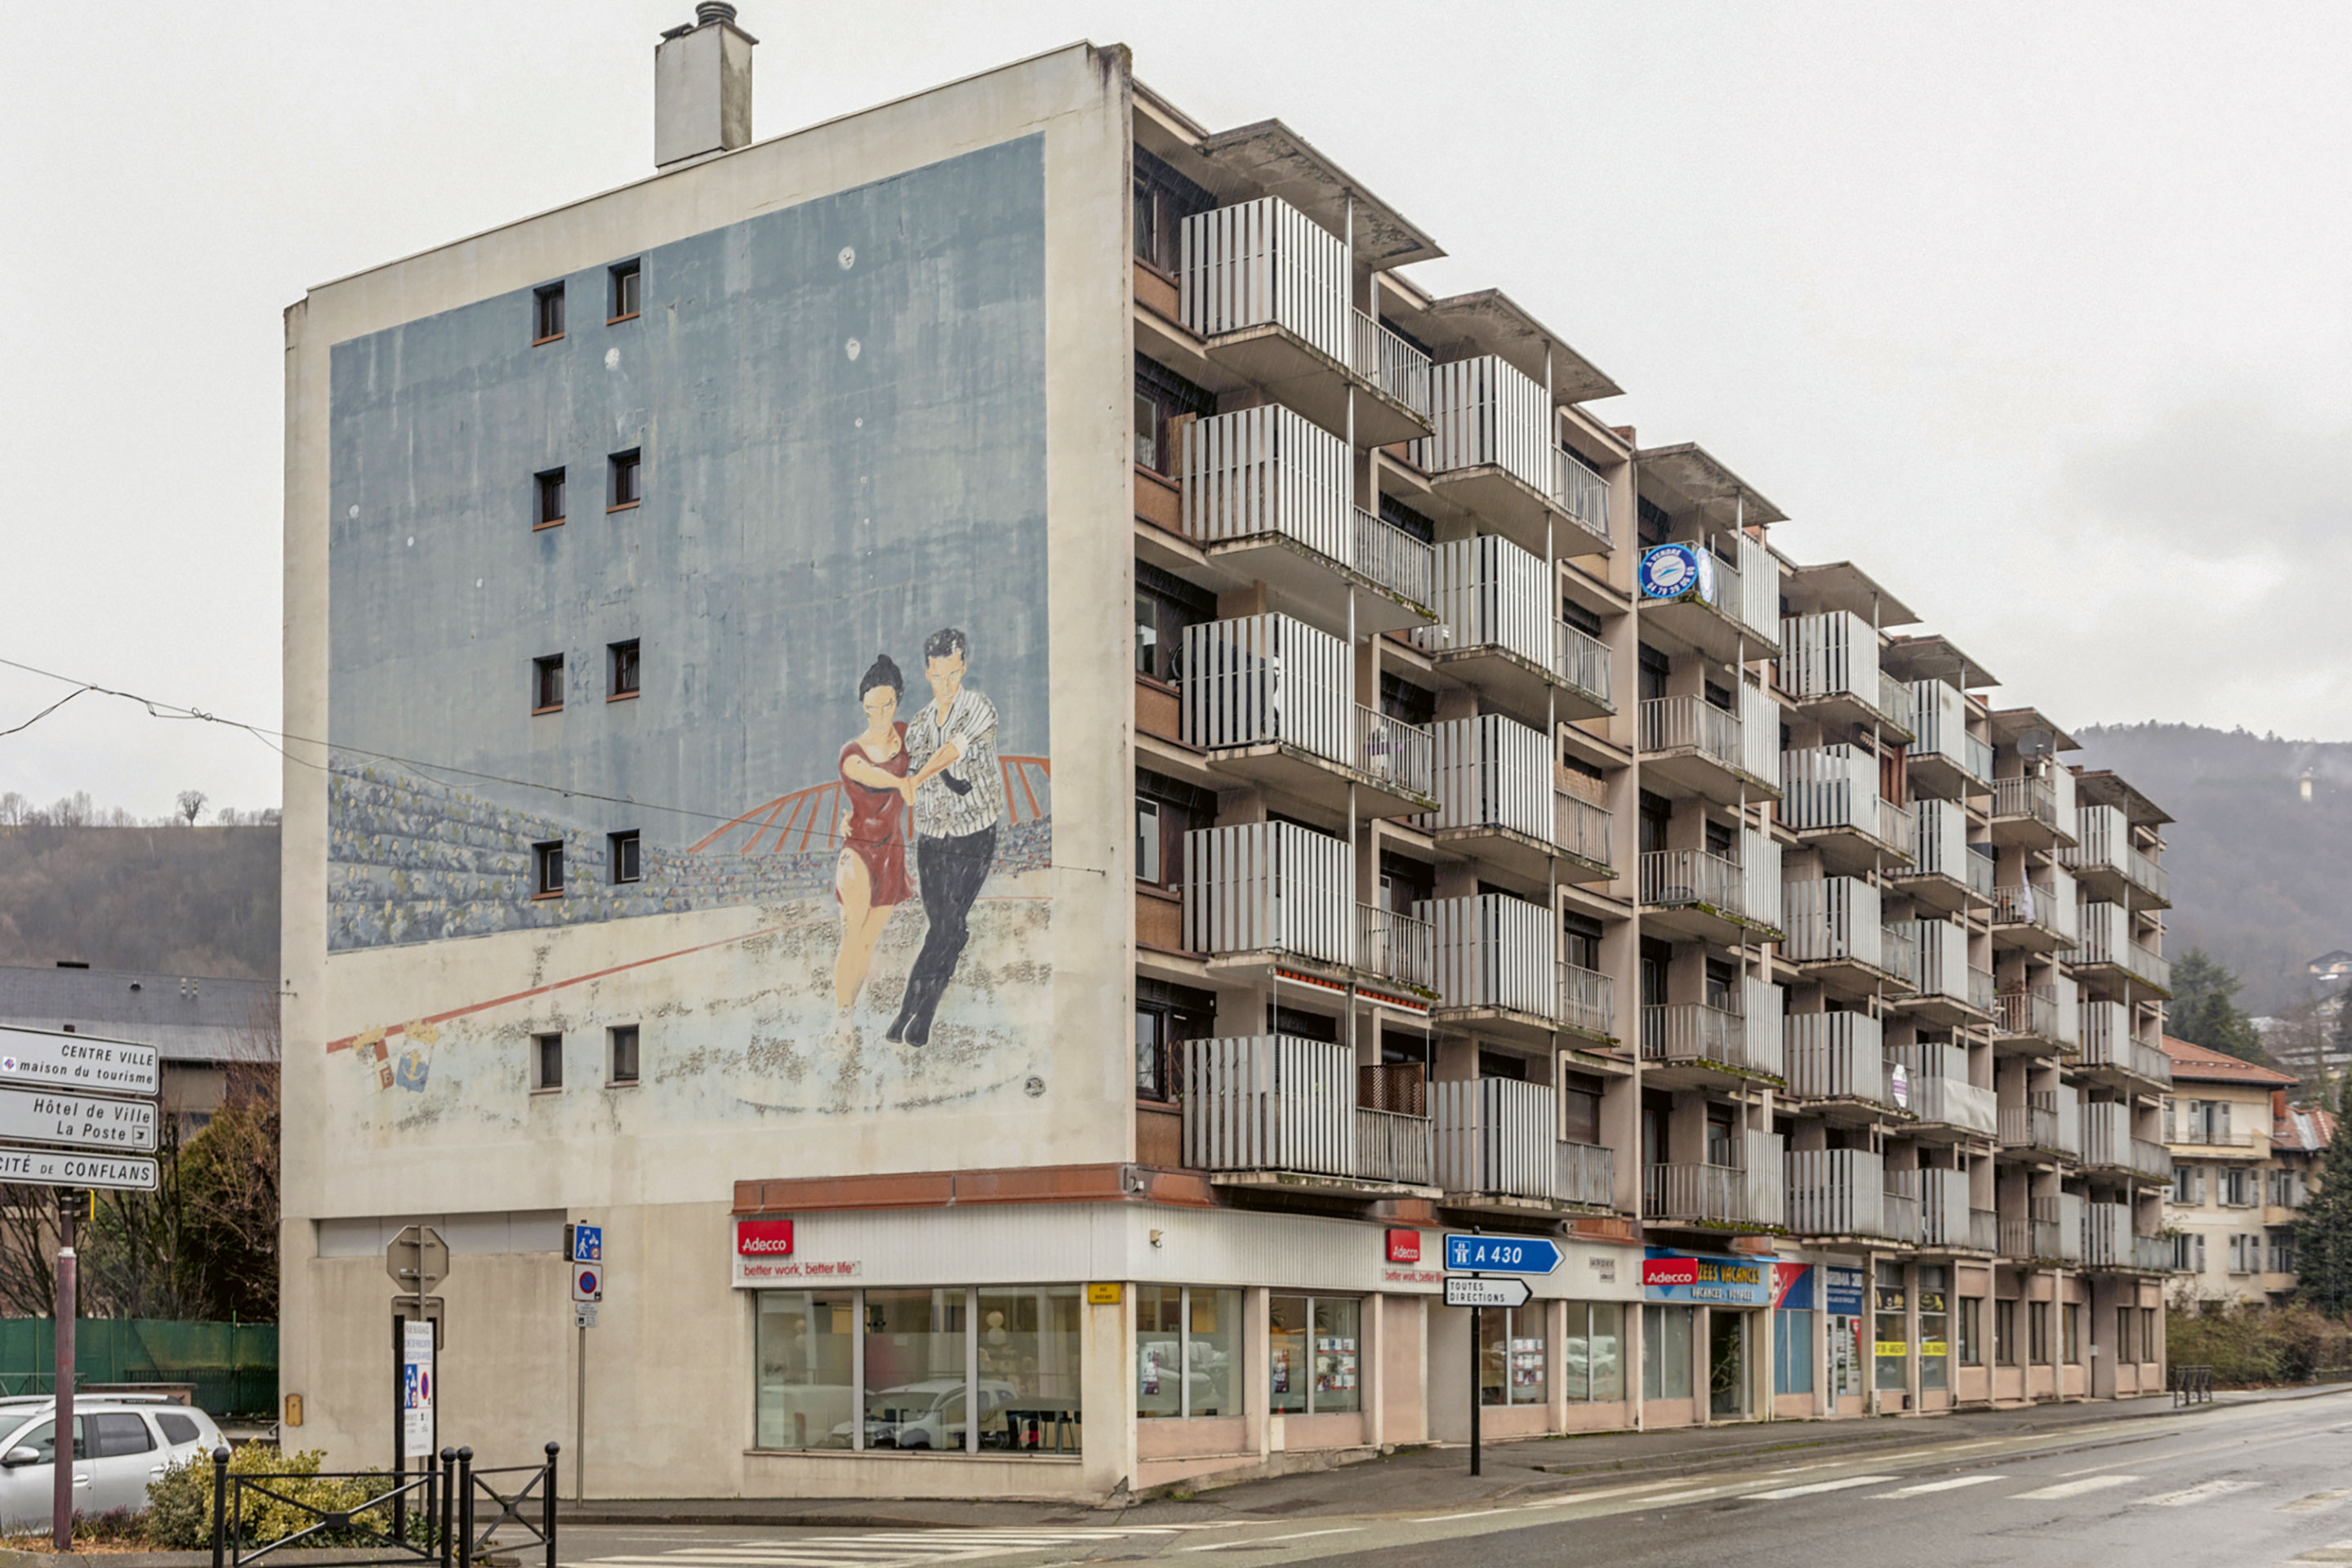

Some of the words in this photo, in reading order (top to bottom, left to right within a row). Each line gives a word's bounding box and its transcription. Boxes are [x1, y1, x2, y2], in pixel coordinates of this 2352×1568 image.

[1650, 548, 1682, 561] VENDRE
[61, 1045, 112, 1062] CENTRE
[120, 1052, 154, 1067] VILLE
[20, 1061, 67, 1075] maison
[74, 1065, 89, 1077] du
[97, 1069, 153, 1085] tourisme
[33, 1098, 78, 1116] Hôtel
[87, 1104, 104, 1119] de
[114, 1107, 150, 1123] Ville
[56, 1120, 74, 1135] La
[82, 1123, 126, 1141] Poste
[41, 1165, 54, 1174] DE
[65, 1161, 150, 1181] CONFLANS
[742, 1237, 786, 1251] Adecco
[1392, 1245, 1419, 1258] Adecco
[1475, 1245, 1486, 1263] A
[1490, 1246, 1522, 1264] 430
[744, 1263, 772, 1276] better
[774, 1263, 803, 1276] work,
[805, 1262, 835, 1275] better
[1385, 1269, 1401, 1281] better
[1698, 1263, 1718, 1281] ZEES
[1721, 1265, 1762, 1285] VACANCES
[1647, 1272, 1692, 1283] Adecco
[1450, 1281, 1484, 1291] TOUTES
[1691, 1287, 1722, 1299] VACANCES
[1450, 1292, 1505, 1303] DIRECTIONS
